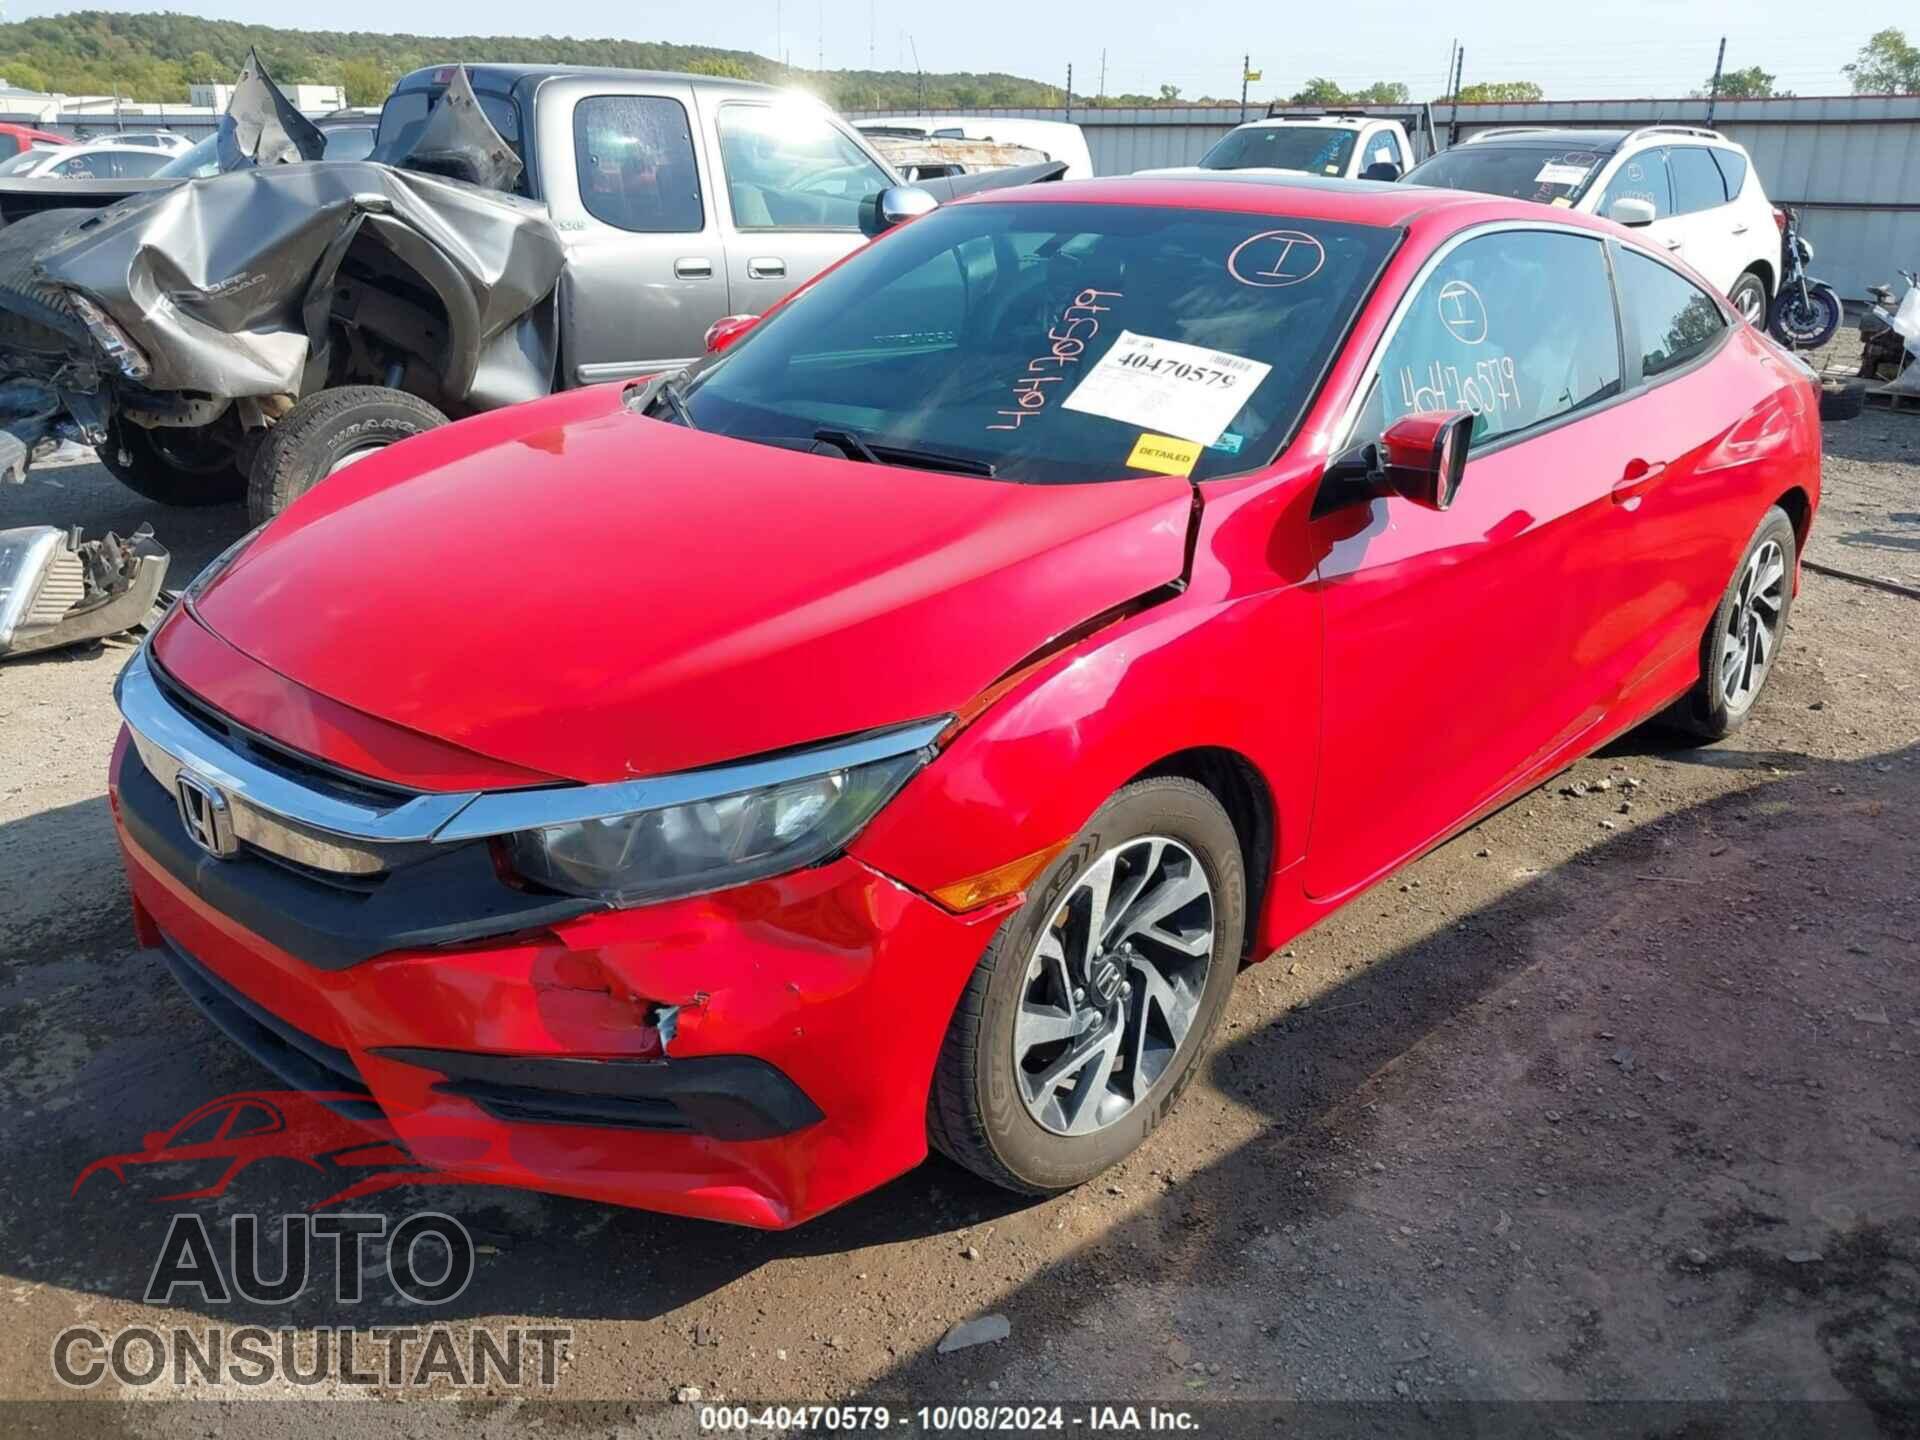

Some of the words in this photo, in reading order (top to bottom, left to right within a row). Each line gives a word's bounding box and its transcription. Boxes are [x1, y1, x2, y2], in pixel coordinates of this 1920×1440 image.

[985, 288, 1124, 430] 40470579
[1118, 352, 1237, 389] 40470579
[1400, 356, 1522, 416] 40470579
[327, 418, 425, 450] WRANG
[1139, 446, 1192, 464] DETAILED
